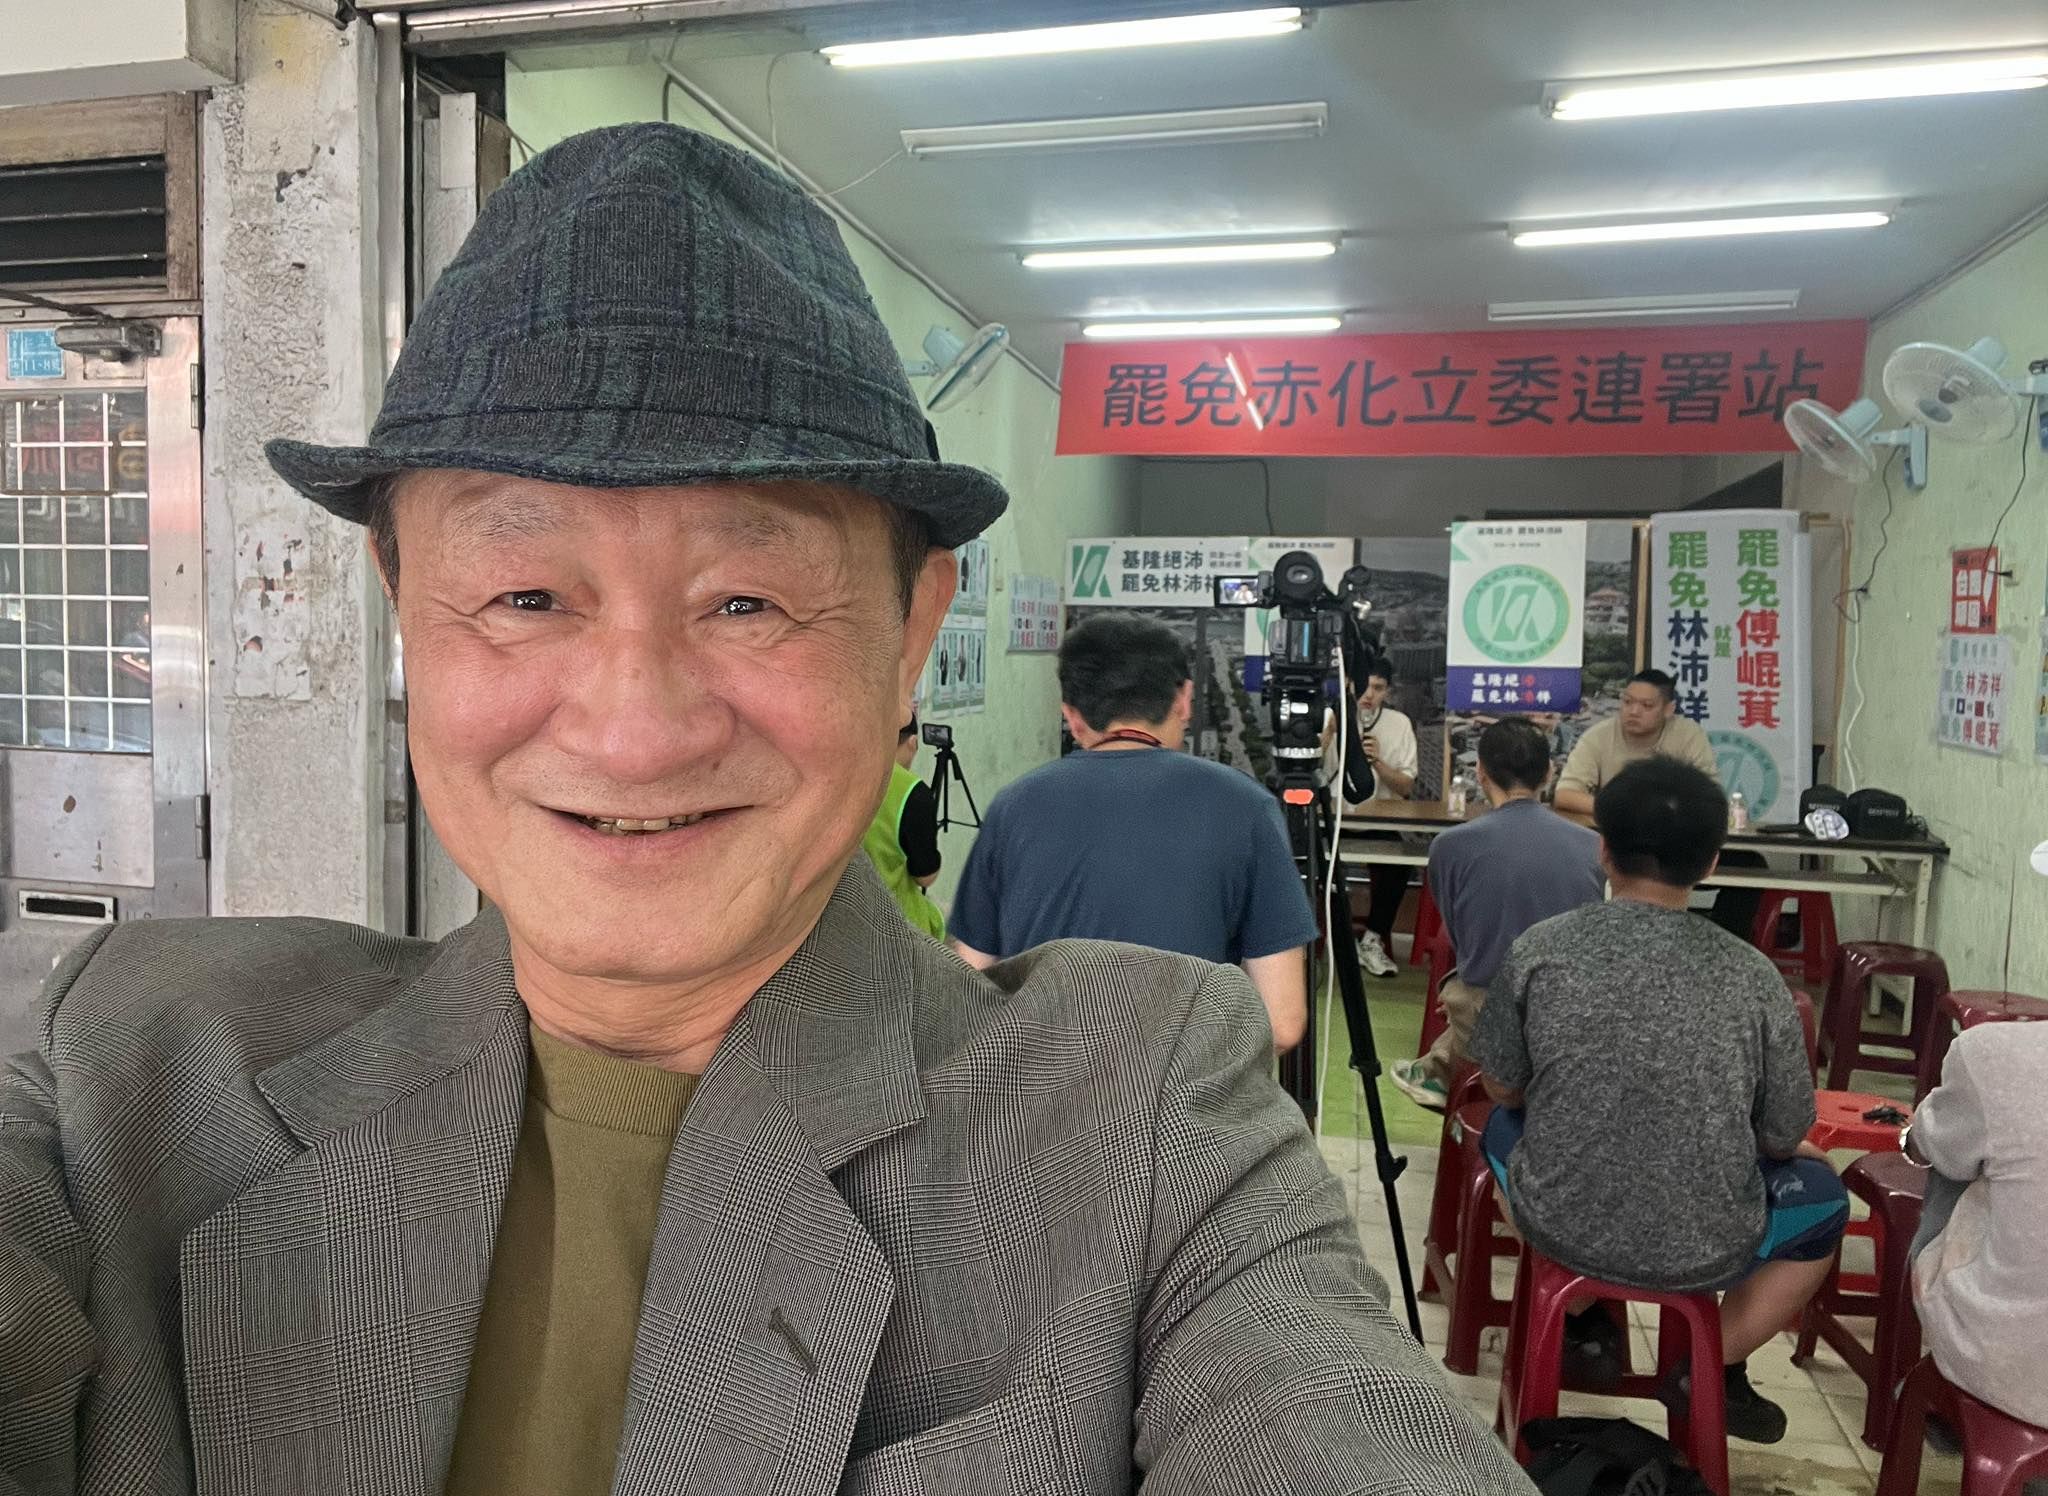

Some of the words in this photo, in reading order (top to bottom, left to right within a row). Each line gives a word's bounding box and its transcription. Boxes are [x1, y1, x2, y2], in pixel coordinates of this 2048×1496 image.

[1102, 348, 1824, 428] 罷免赤化立委連署站
[1122, 550, 1203, 569] 基隆絕沛
[1667, 531, 1710, 724] 罷免林沛祥
